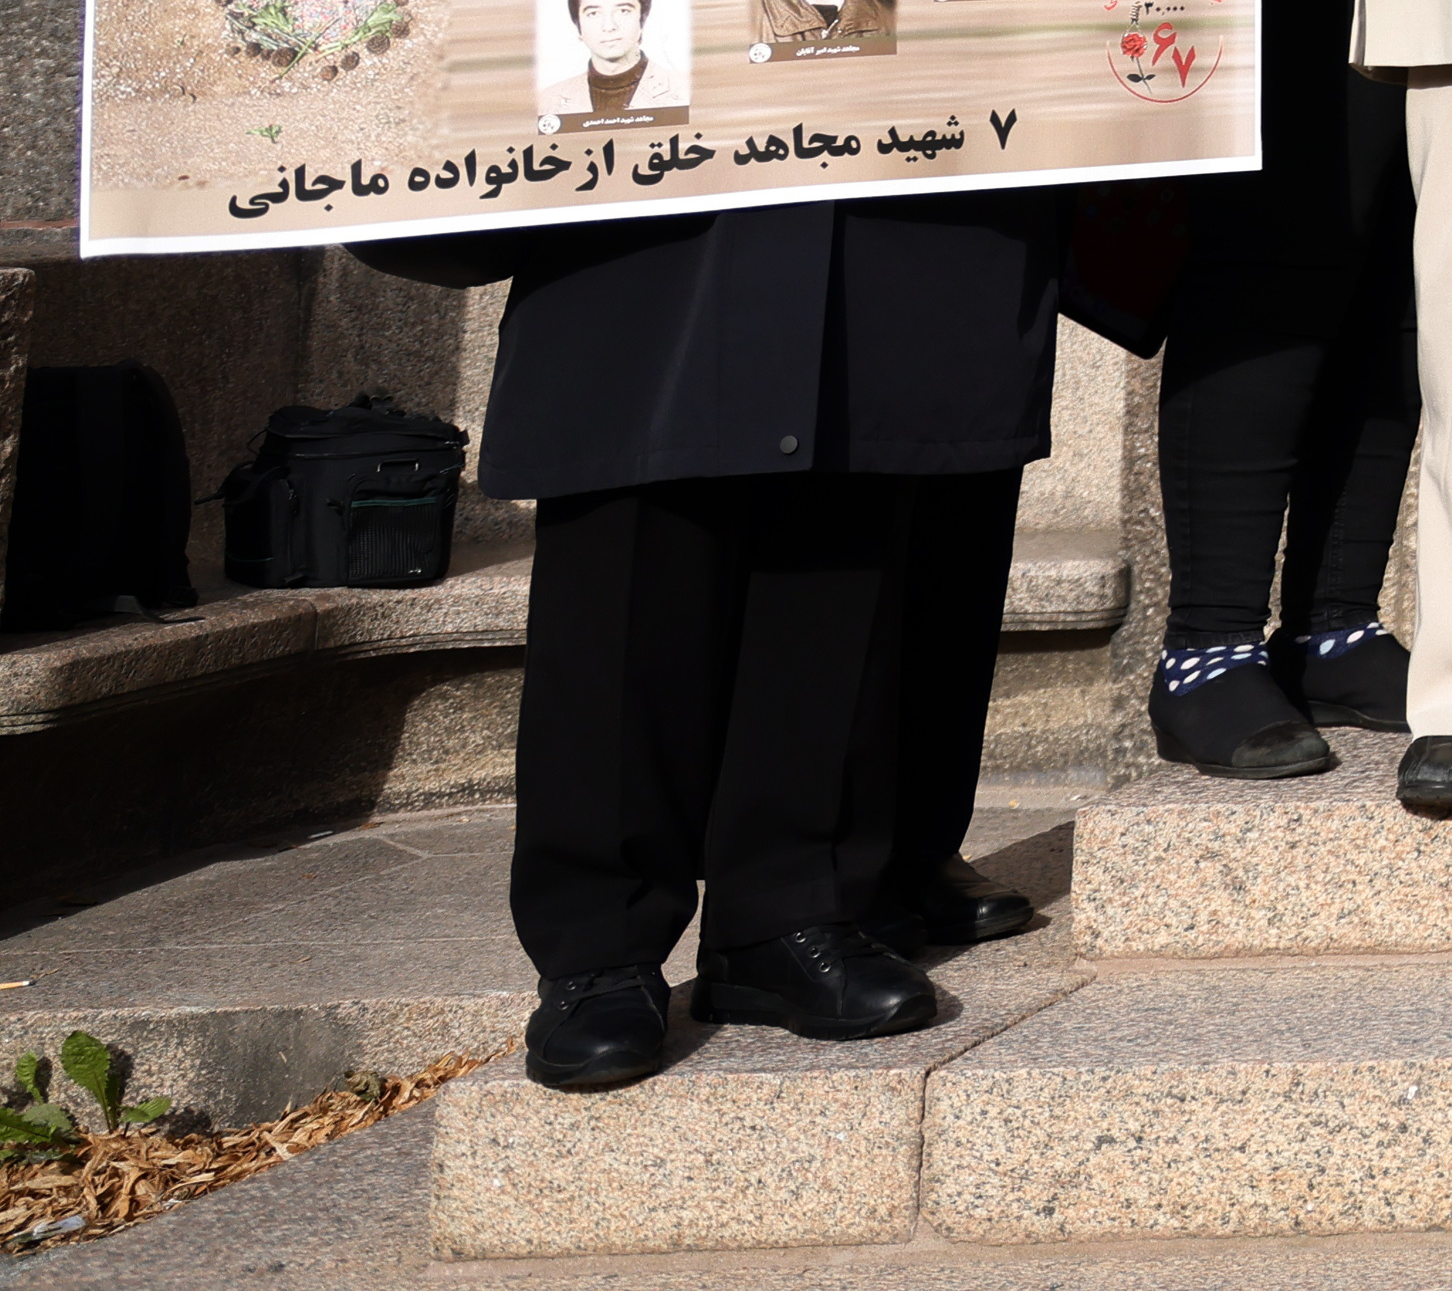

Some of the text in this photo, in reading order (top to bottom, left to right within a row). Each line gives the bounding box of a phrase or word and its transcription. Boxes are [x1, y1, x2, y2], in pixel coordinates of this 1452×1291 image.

[228, 107, 1018, 221] ۷ شهید مجاهد خلق از خانواده ماجانی
